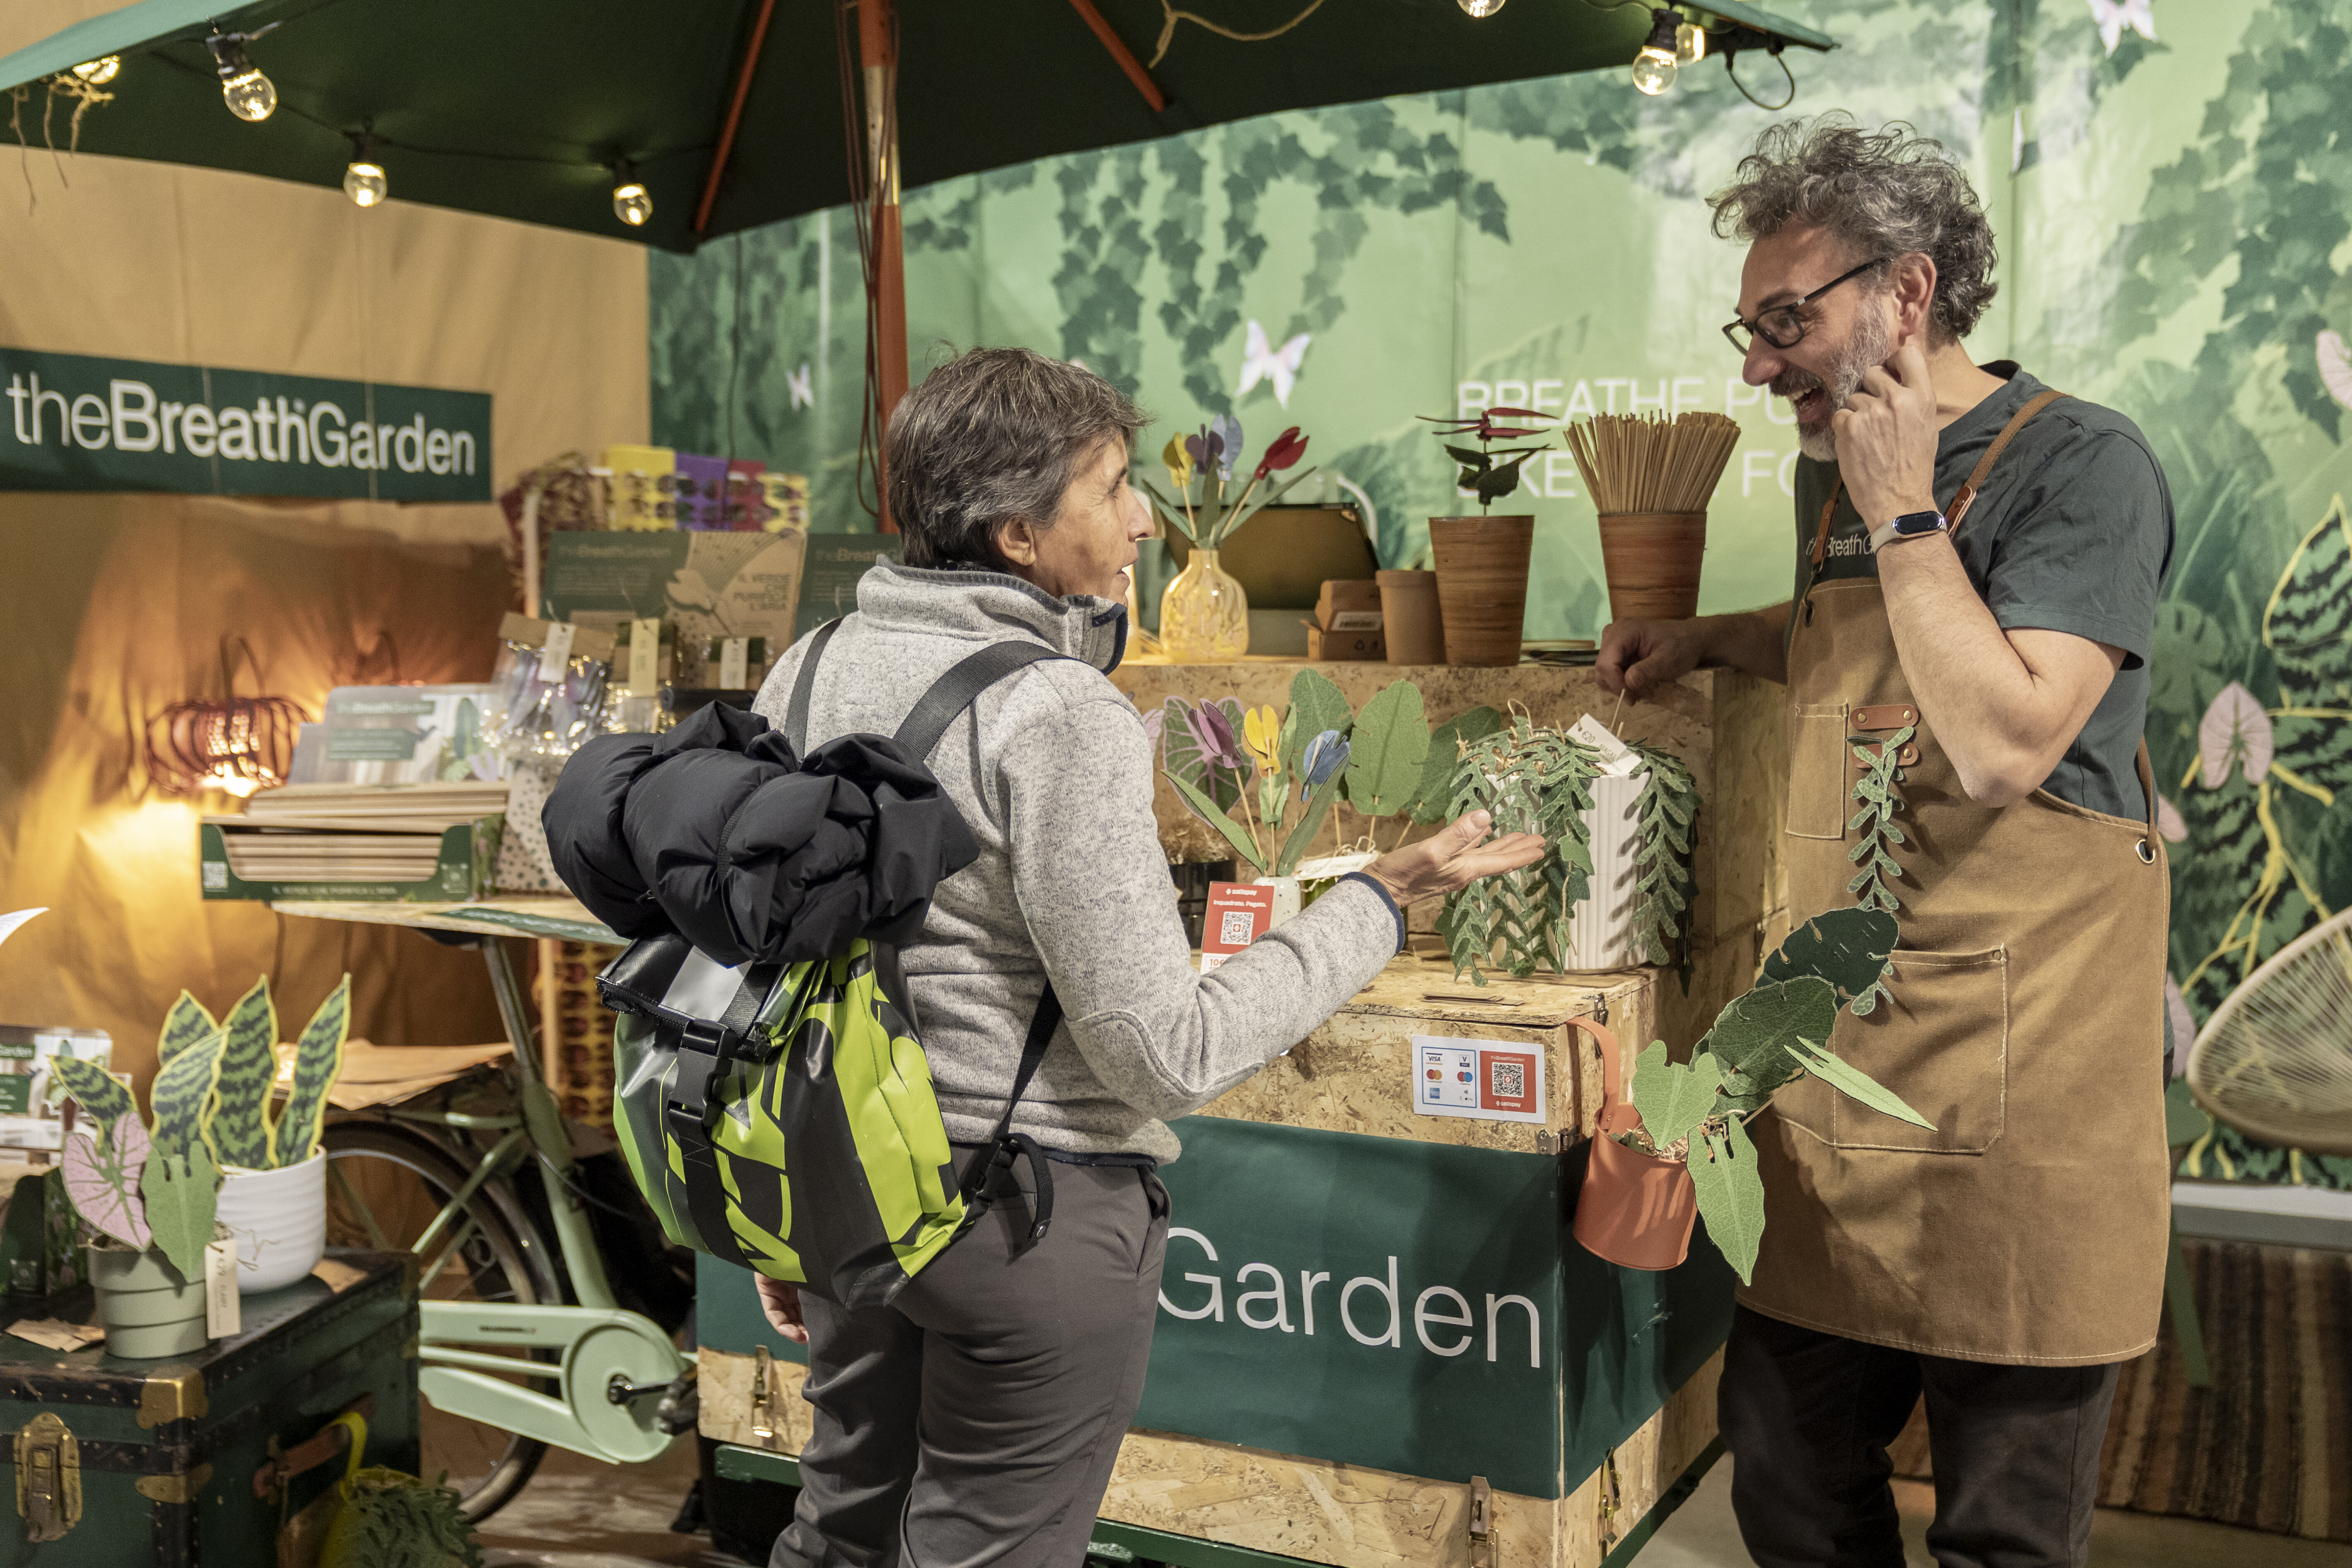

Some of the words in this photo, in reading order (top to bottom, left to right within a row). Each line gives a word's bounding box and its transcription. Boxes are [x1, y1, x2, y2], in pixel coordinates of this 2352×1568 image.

[1582, 731, 1596, 744] €20
[1598, 743, 1620, 762] NIAGARA
[1158, 1227, 1540, 1368] Garden
